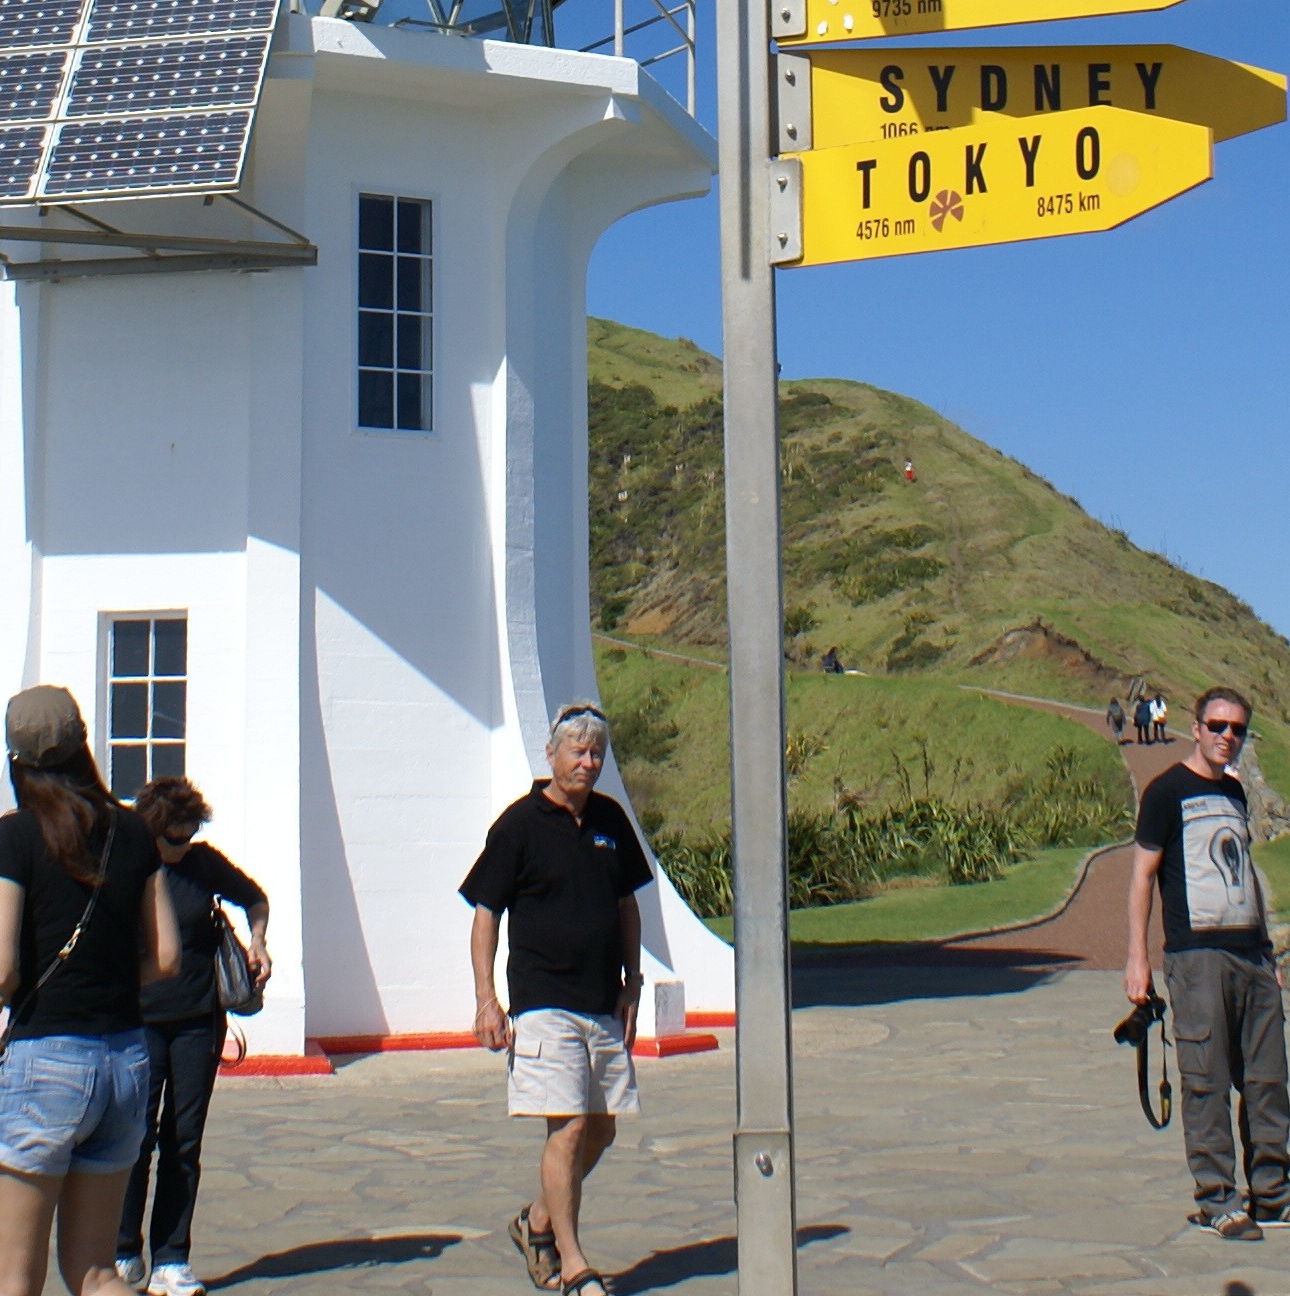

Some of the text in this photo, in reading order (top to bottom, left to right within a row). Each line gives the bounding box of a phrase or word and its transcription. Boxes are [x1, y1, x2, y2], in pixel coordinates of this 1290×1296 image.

[878, 62, 1164, 114] SYDNEY
[880, 122, 919, 139] 1066
[856, 125, 1102, 210] TOKYO
[1037, 192, 1101, 218] 8475 km
[855, 218, 916, 241] 4576 nm
